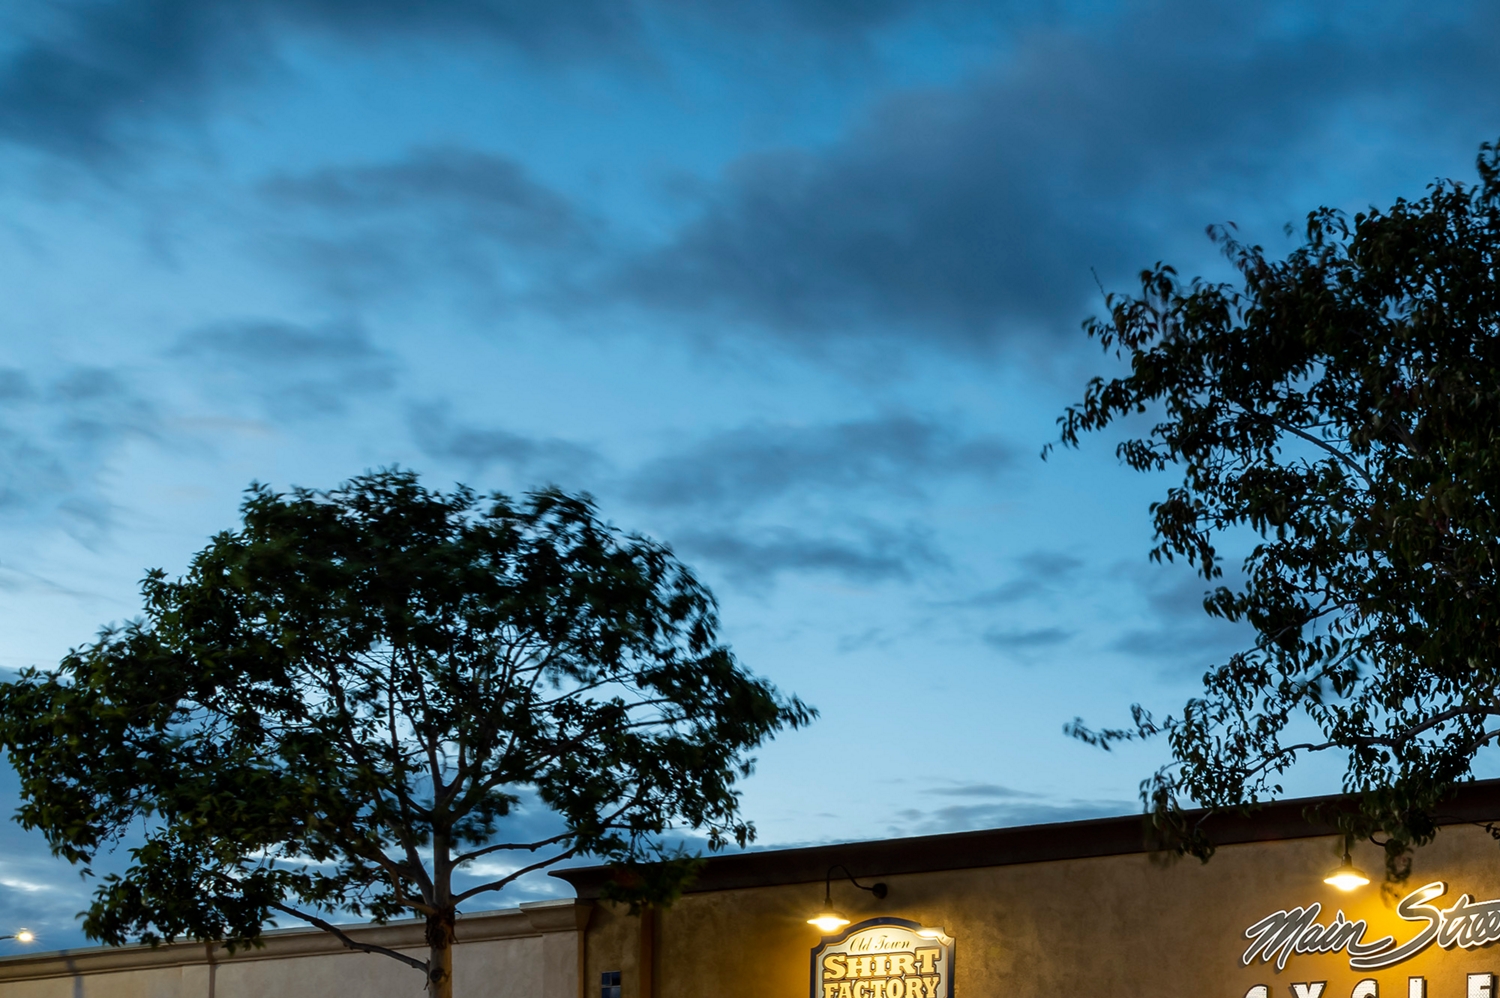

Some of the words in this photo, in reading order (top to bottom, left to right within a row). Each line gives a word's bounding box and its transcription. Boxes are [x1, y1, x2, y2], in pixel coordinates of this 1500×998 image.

[850, 936, 873, 952] Old
[874, 934, 911, 950] Town
[1242, 902, 1397, 970] Main
[823, 947, 941, 980] SHIRT
